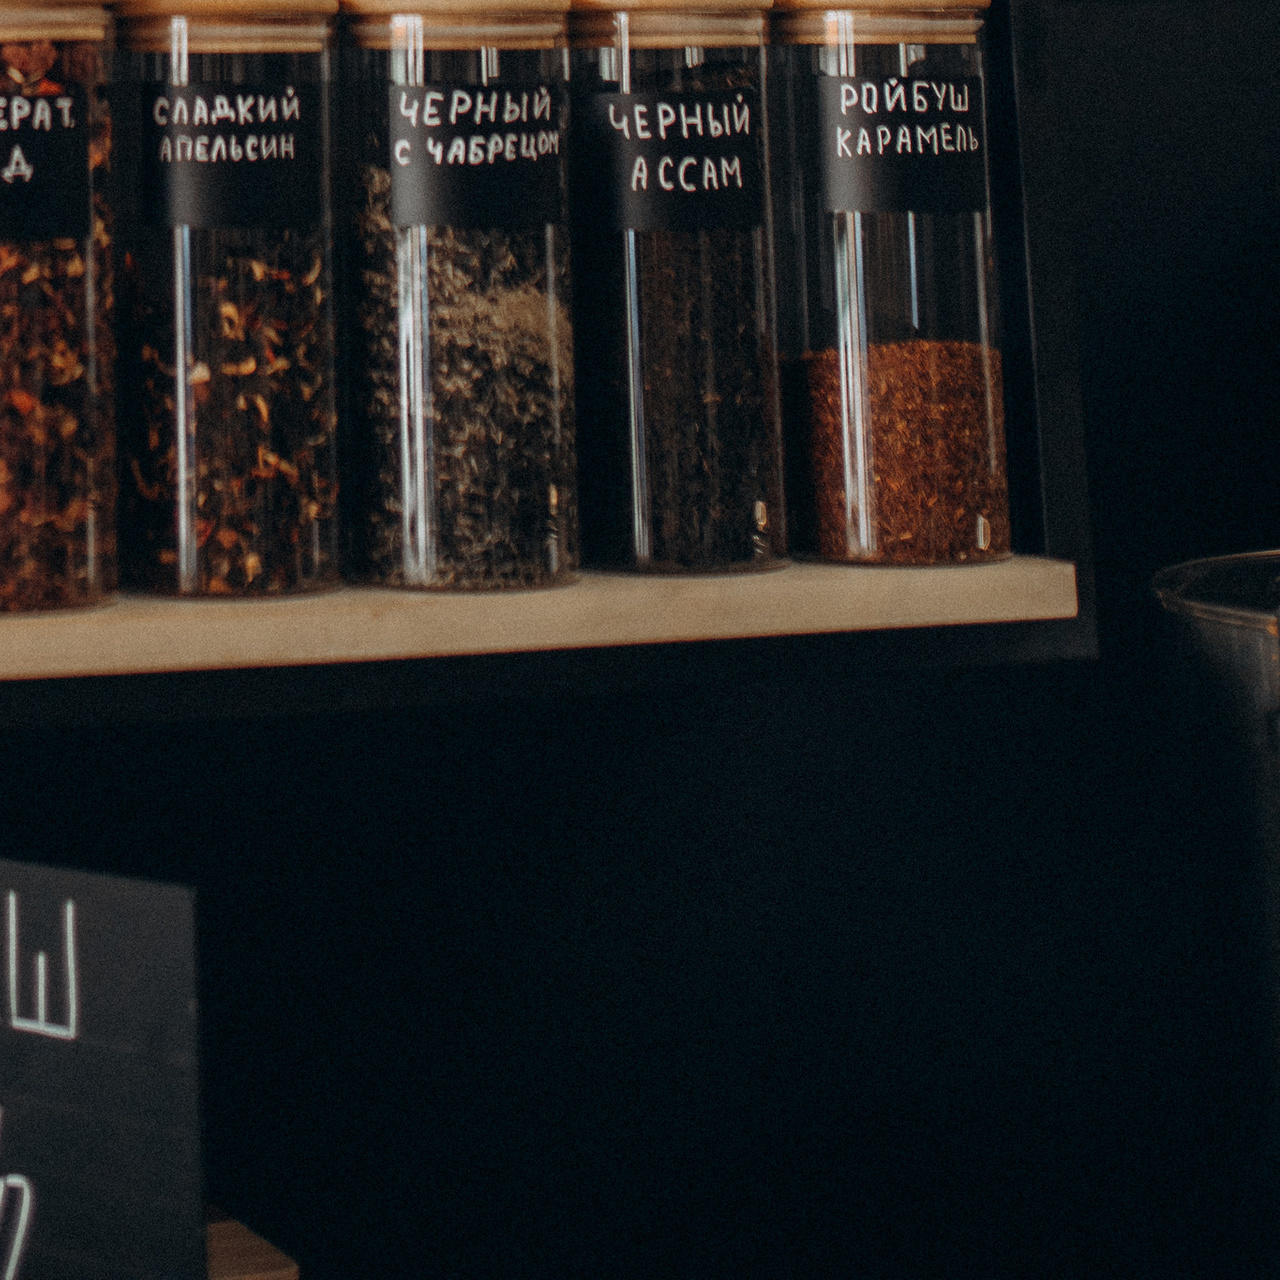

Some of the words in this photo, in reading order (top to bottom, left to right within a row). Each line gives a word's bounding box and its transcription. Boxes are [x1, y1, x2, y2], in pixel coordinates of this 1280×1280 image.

[153, 85, 300, 126] СЛАДКИЙ
[400, 86, 551, 127] ЧЕРНЫЙ
[839, 78, 969, 115] РОЙБУШ
[608, 93, 750, 140] ЧЕРНЫЙ
[159, 133, 295, 163] АПЕЛЬСИН
[427, 130, 559, 166] ЧАБРЕЦОМ
[836, 122, 979, 158] КАРАМЕЛЬ
[631, 155, 743, 192] АССАМ
